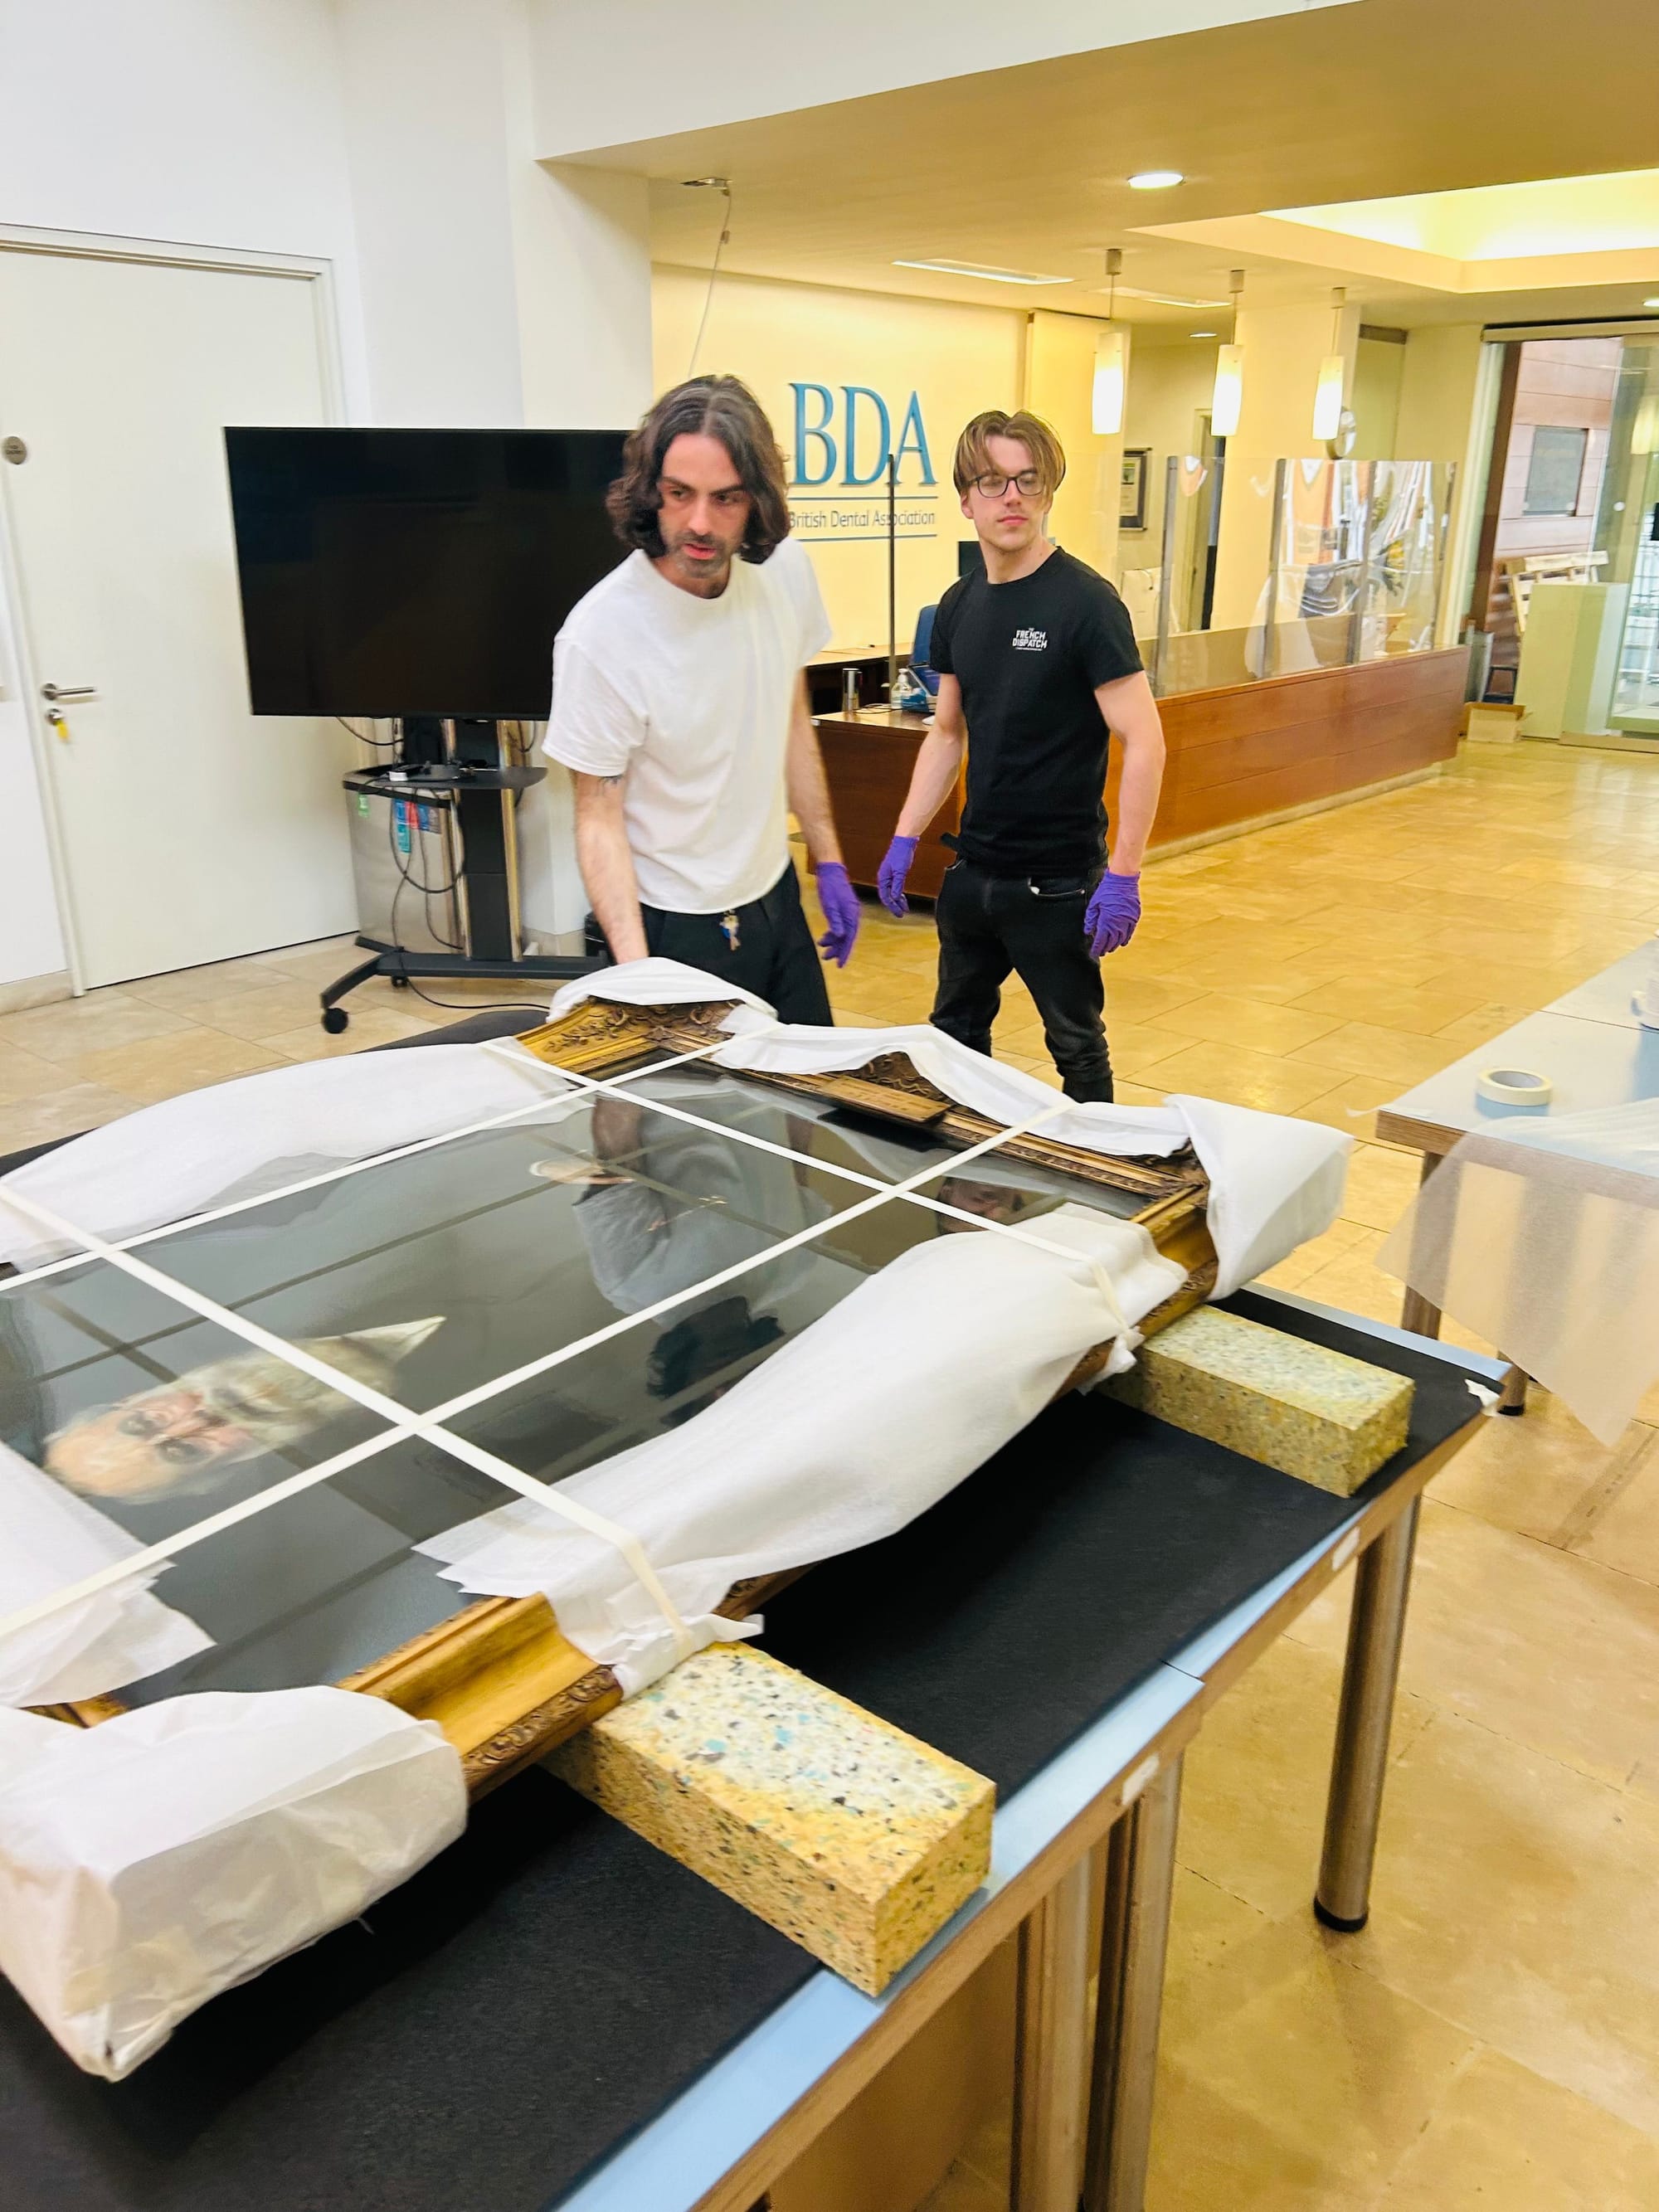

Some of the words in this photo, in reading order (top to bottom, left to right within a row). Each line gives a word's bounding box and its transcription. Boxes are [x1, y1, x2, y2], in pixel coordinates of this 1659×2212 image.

[788, 382, 938, 486] BDA
[789, 510, 826, 528] British
[830, 510, 869, 527] Dental
[1016, 630, 1046, 640] FRENCH
[1012, 637, 1048, 649] DISPATCH
